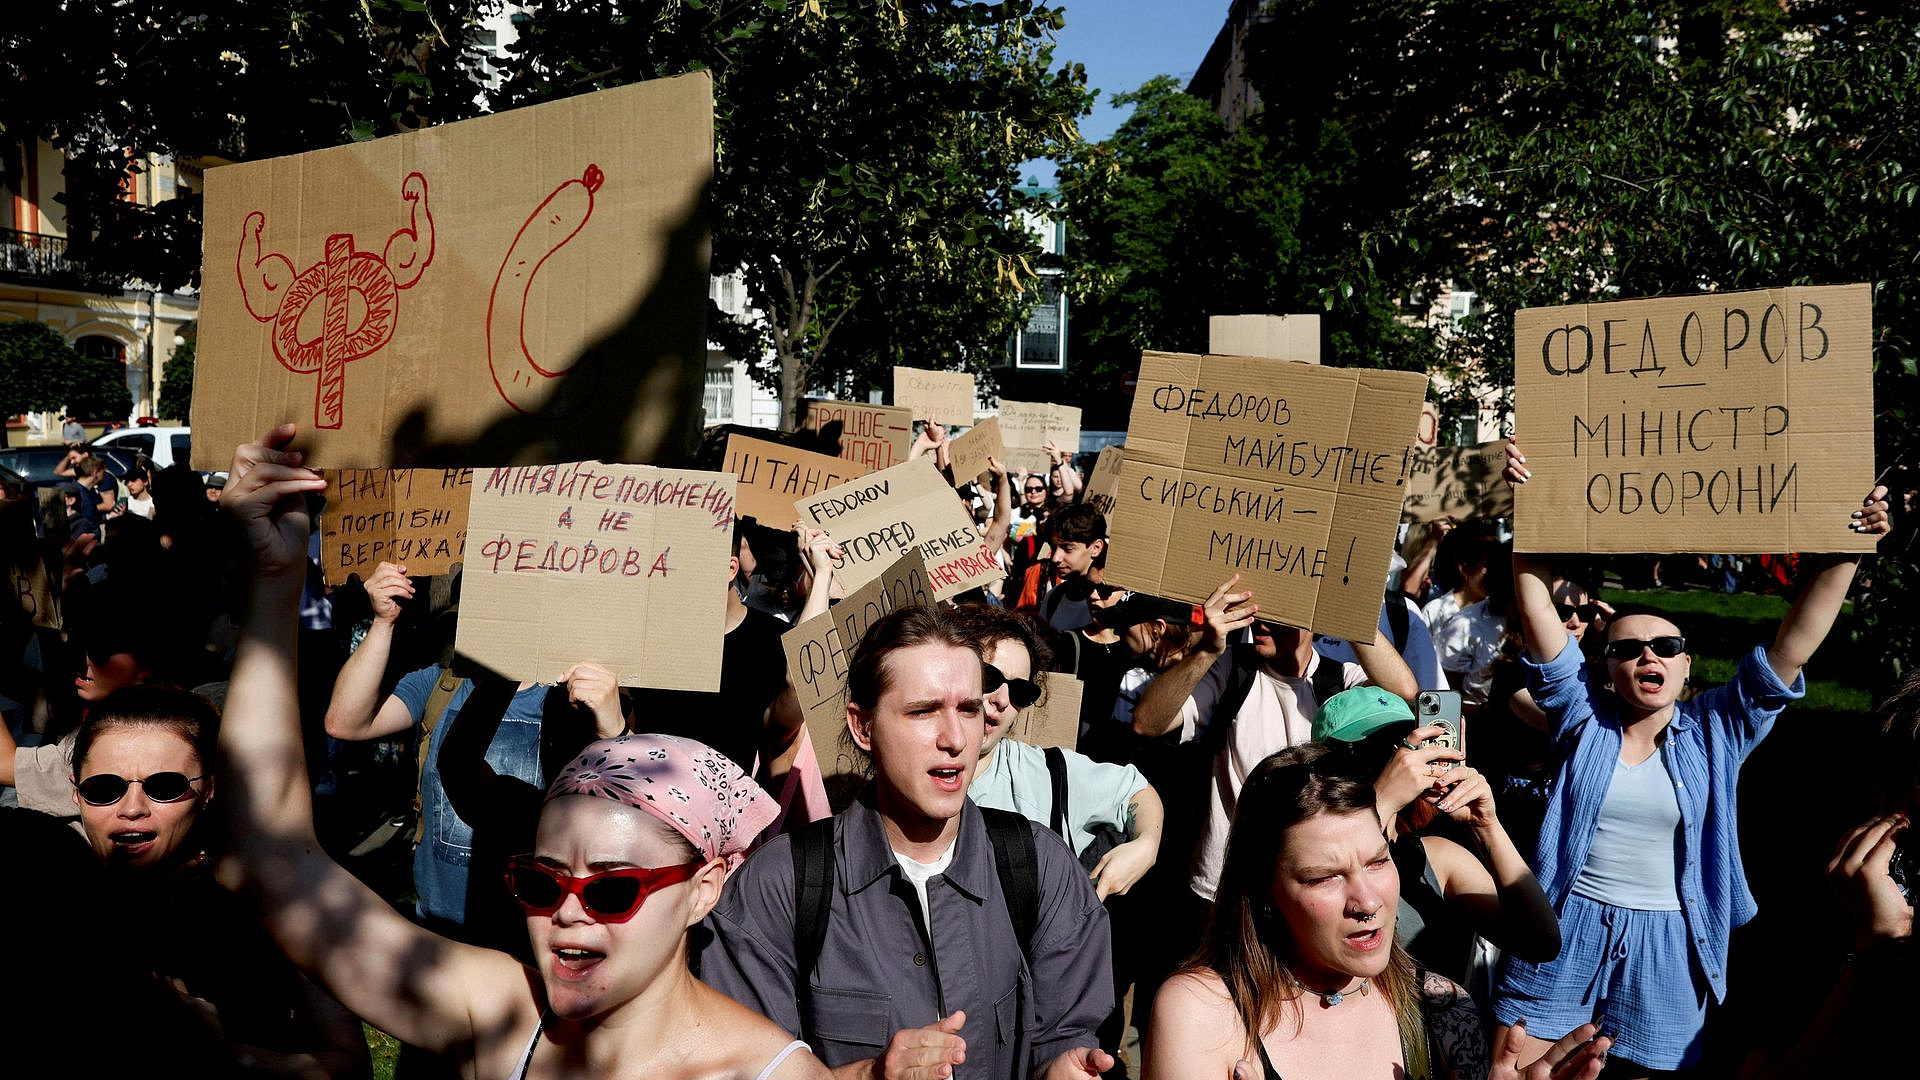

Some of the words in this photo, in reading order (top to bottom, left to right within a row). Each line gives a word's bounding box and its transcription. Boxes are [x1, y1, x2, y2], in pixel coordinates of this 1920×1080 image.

[1542, 302, 1829, 377] ФЕДОРОВ
[1152, 384, 1291, 425] ФЕДОРОВ
[1573, 400, 1789, 458] МІНІСТР
[338, 468, 414, 500] НАМ
[442, 468, 473, 490] НЕ
[808, 479, 889, 524] FEDOROV
[1140, 475, 1284, 523] СИРСЬКИЙ
[1586, 462, 1798, 516] ОБОРОНИ
[598, 508, 633, 531] НЕ
[481, 533, 672, 578] ФЕДОРОВА
